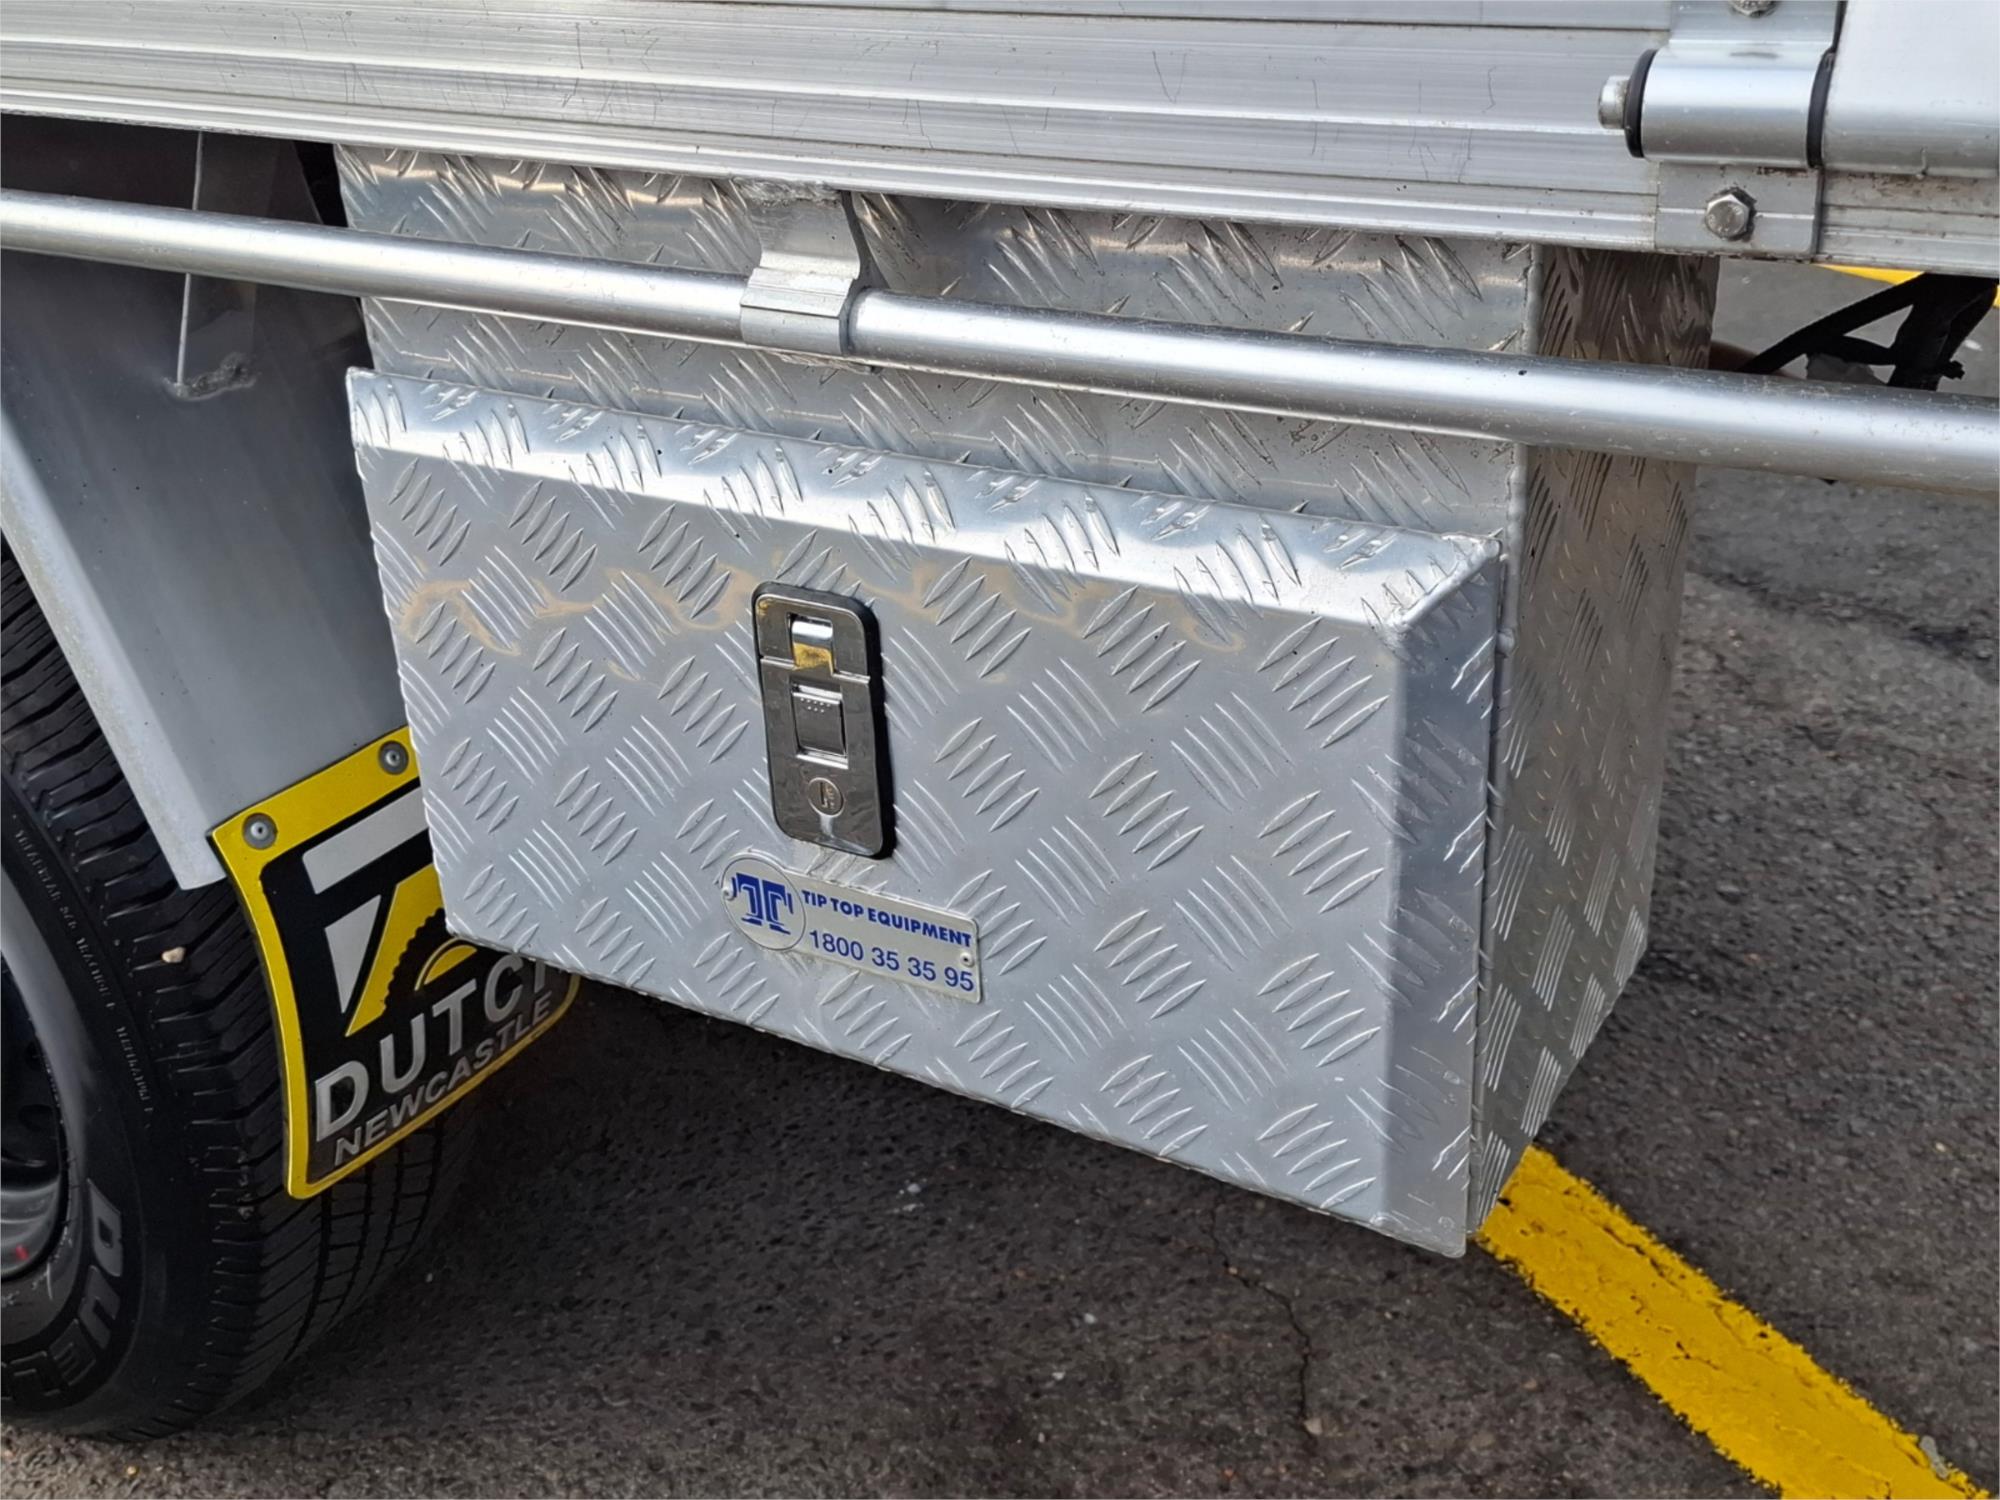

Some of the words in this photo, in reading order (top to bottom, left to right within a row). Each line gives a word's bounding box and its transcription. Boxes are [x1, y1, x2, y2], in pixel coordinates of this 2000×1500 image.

[801, 889, 827, 908] TIP
[830, 898, 864, 918] TOP
[868, 908, 972, 948] EQUIPMENT
[809, 930, 864, 962] 1800
[871, 947, 900, 971] 35
[907, 957, 936, 981] 35
[944, 967, 974, 992] 95
[334, 990, 552, 1168] NEWCASTLE
